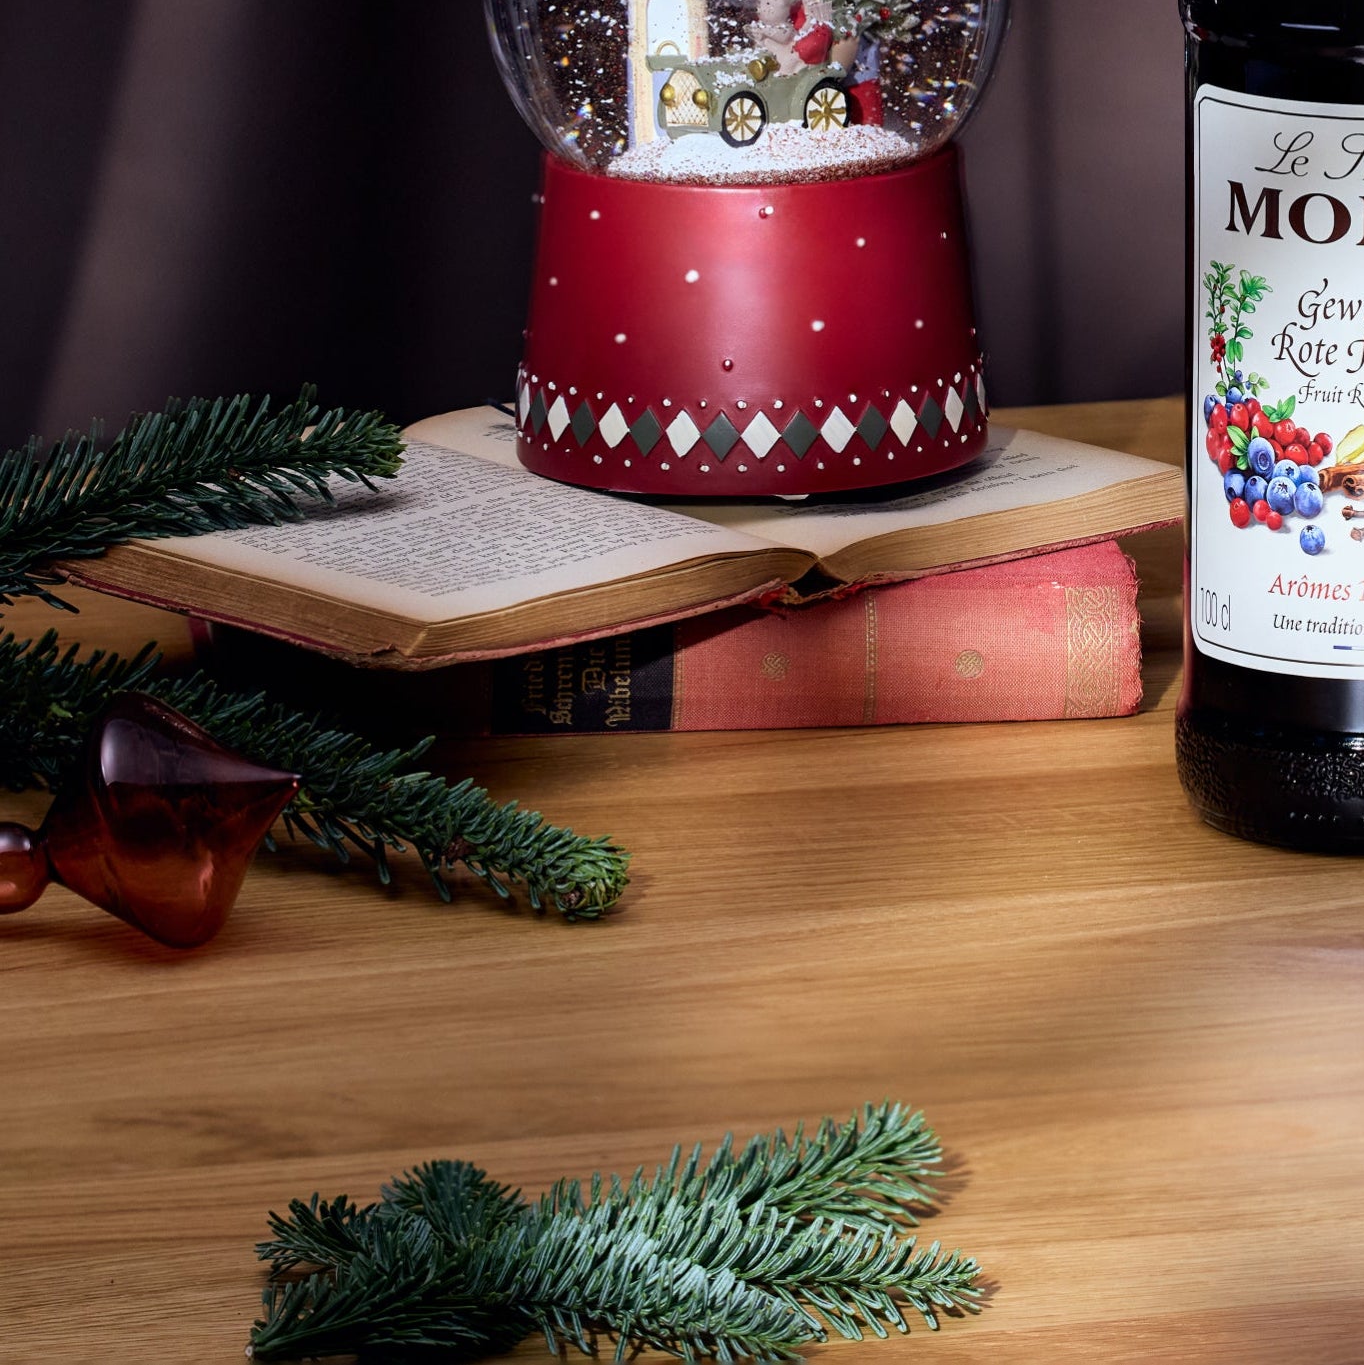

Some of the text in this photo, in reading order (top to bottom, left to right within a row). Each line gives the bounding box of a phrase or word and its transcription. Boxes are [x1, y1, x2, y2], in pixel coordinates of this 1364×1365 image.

[1254, 131, 1314, 177] Le
[1271, 321, 1338, 378] Rote
[1298, 379, 1344, 404] Fruit
[1200, 587, 1231, 632] 100 cl
[1268, 573, 1351, 601] Arômes
[1272, 613, 1303, 632] Une
[521, 652, 546, 715] Fried
